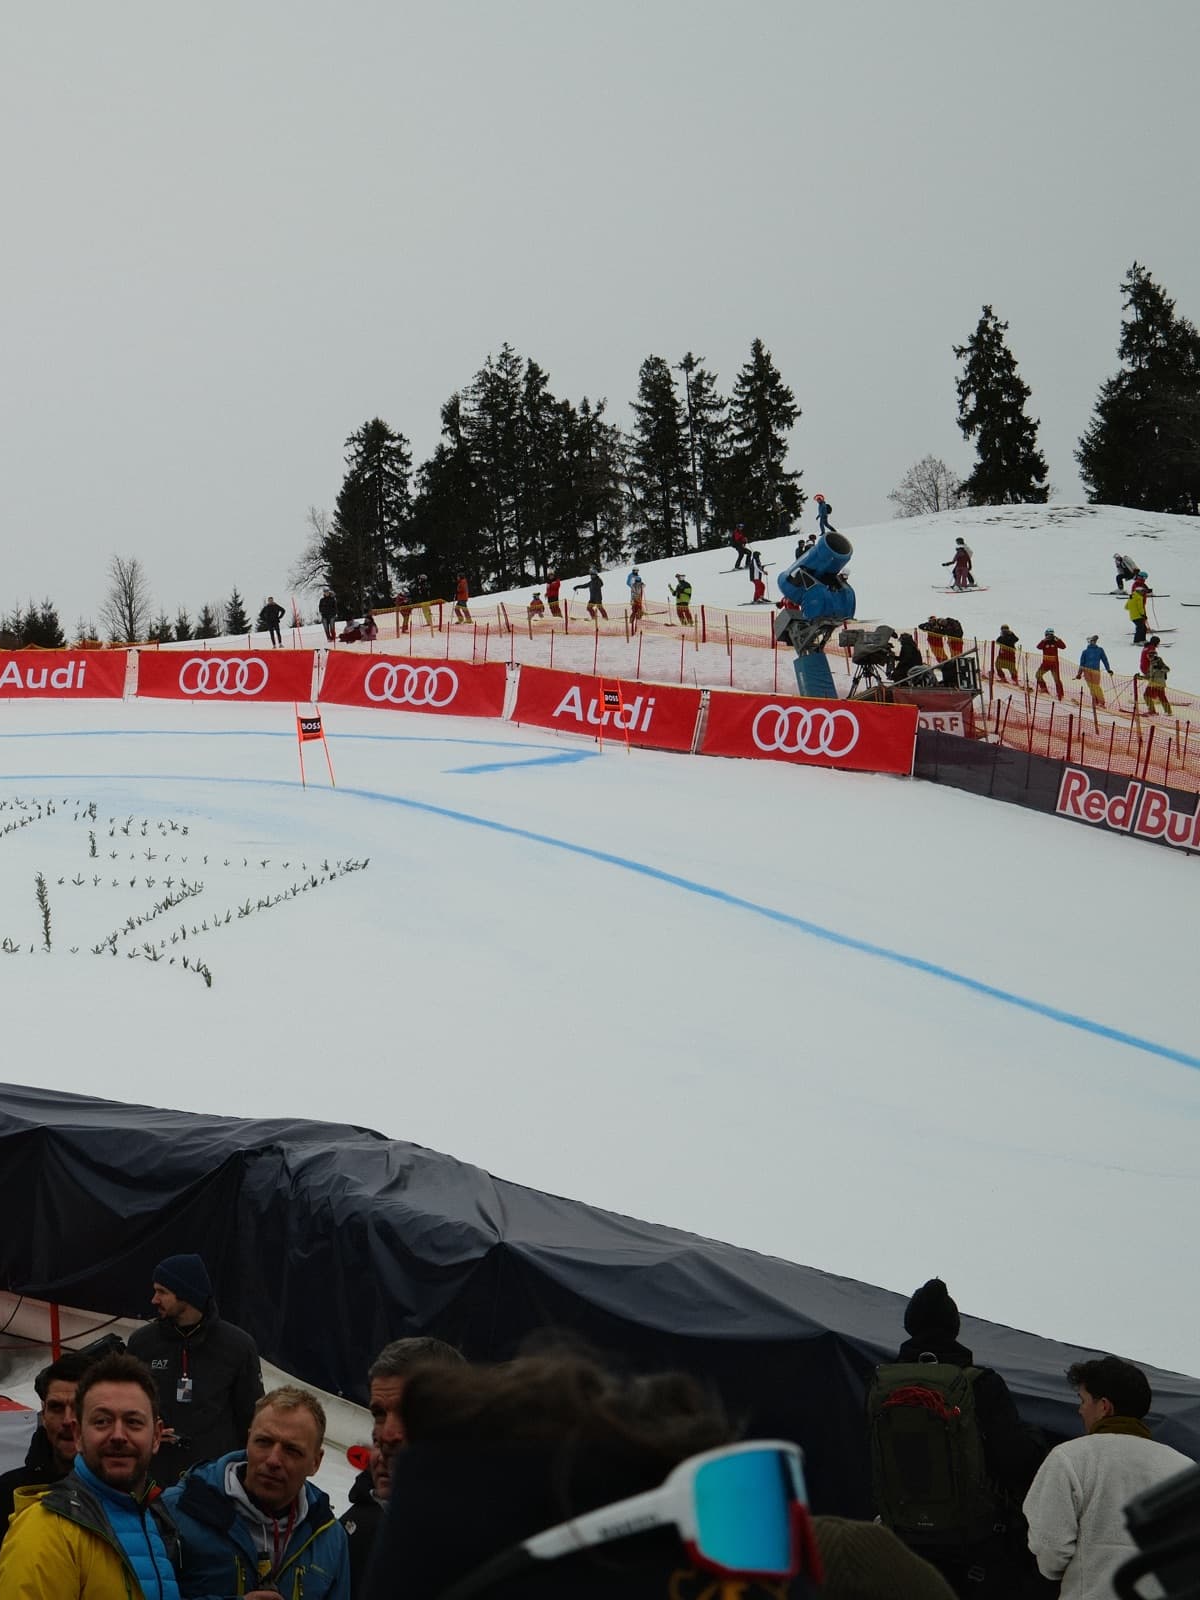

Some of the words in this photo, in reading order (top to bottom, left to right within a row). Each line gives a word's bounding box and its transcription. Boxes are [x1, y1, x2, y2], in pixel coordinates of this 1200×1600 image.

[552, 686, 656, 732] Audi
[604, 694, 619, 702] BOSS
[1057, 768, 1141, 831] Red
[152, 1359, 168, 1369] EA7
